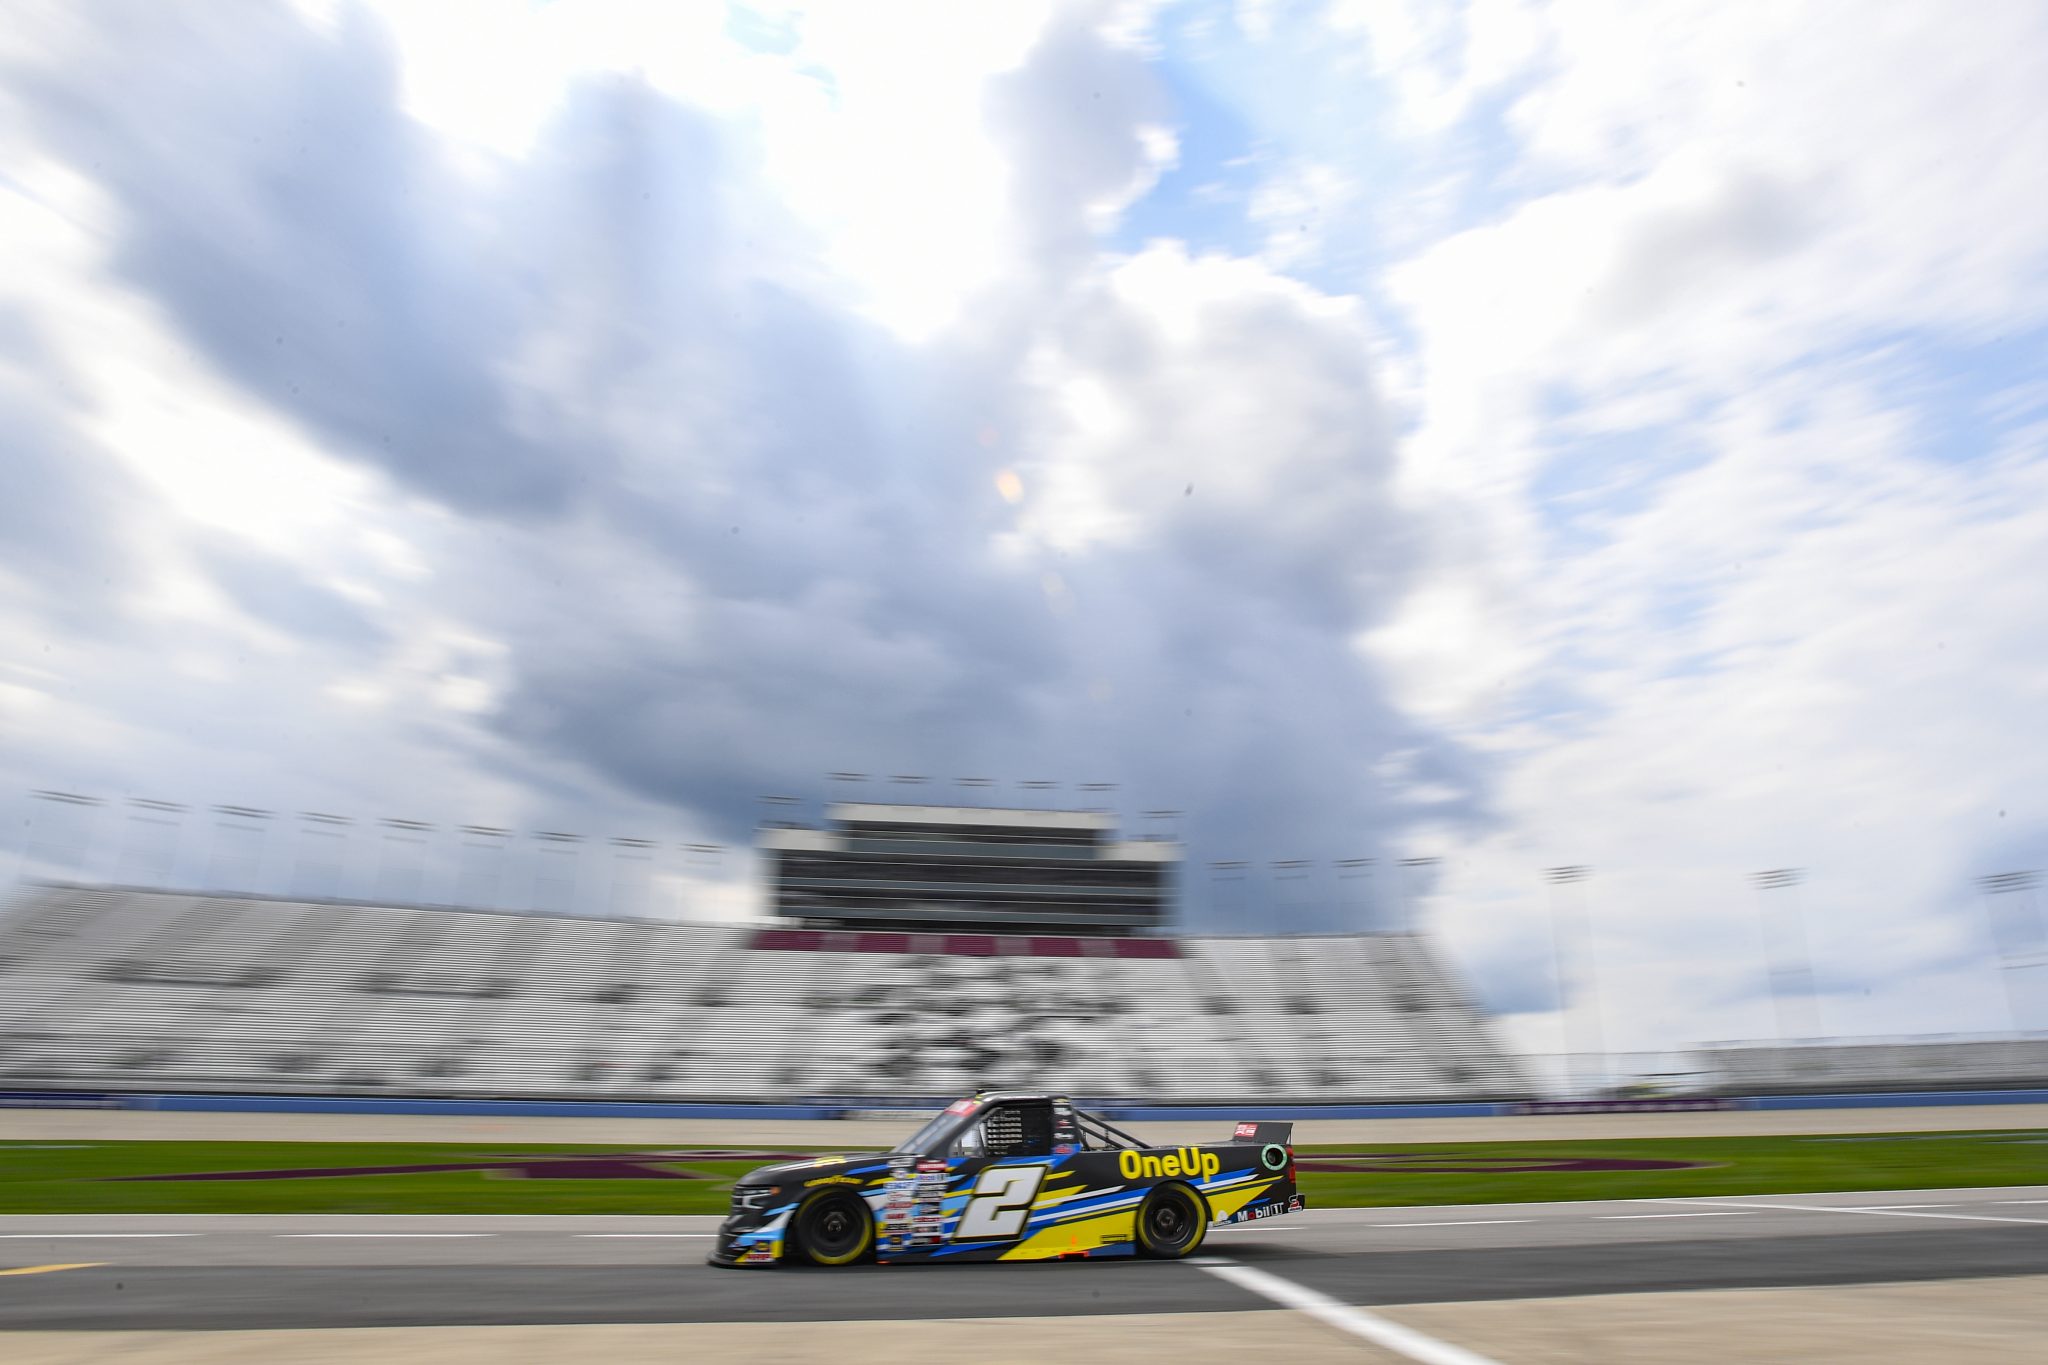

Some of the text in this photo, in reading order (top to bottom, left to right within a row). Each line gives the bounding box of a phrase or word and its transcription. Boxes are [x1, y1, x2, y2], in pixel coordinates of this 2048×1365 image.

[1119, 1147, 1219, 1183] OneUp
[952, 1165, 1048, 1241] 2
[1237, 1206, 1270, 1221] Mobil
